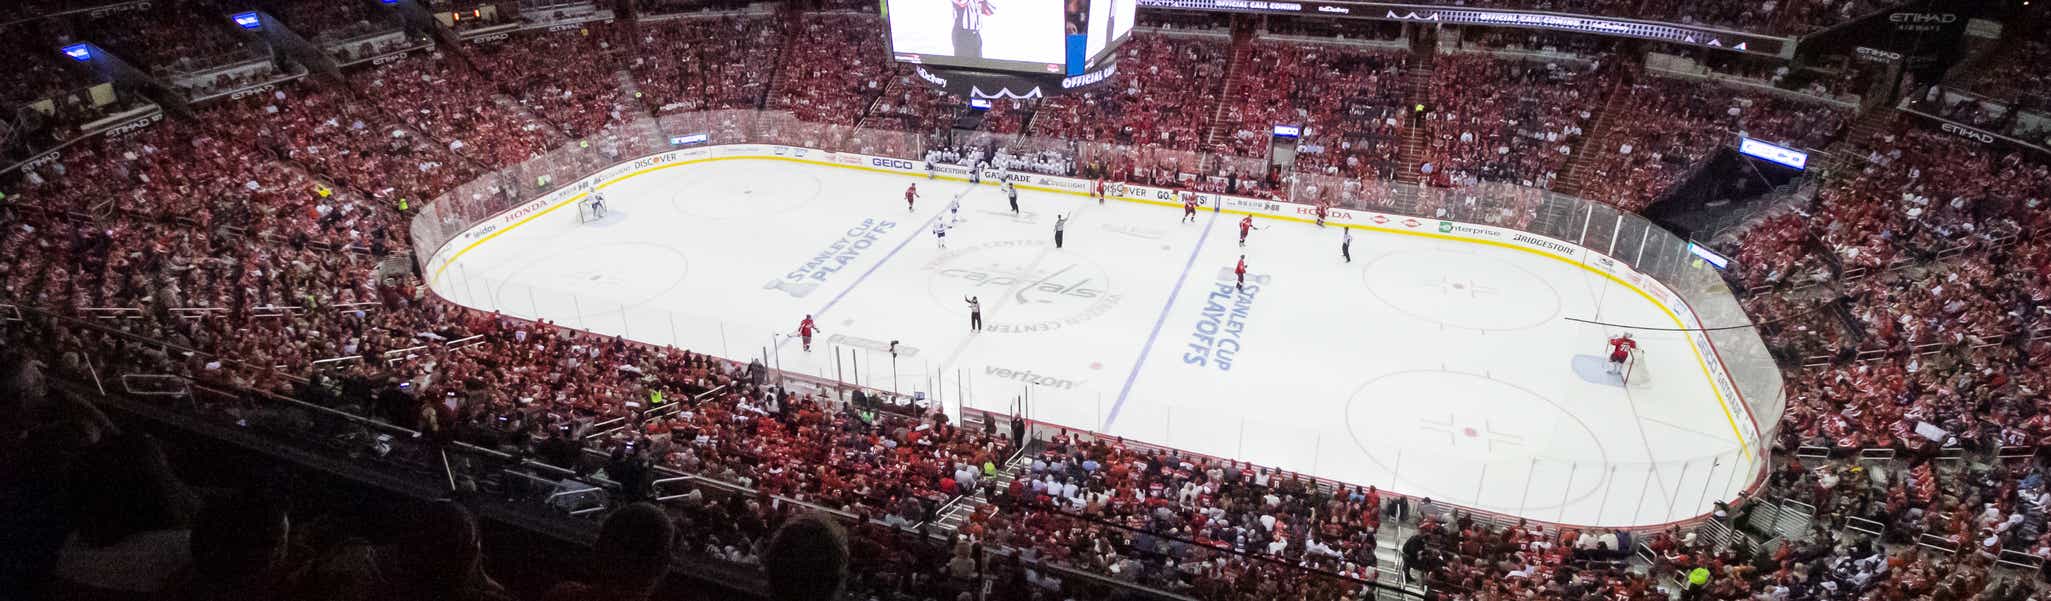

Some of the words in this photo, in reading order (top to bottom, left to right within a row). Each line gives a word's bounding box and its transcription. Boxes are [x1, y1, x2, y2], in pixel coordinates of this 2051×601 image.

[1216, 0, 1248, 9] OFFICIAL
[1250, 1, 1269, 10] CALL
[1269, 3, 1302, 12] COMING
[1889, 12, 1957, 24] ETIHAD
[473, 33, 509, 44] ETIHAD
[373, 52, 408, 65] ETIHAD
[1856, 46, 1900, 60] ETIHAD
[1062, 70, 1103, 88] OFFICIAL
[105, 118, 150, 136] ETIHAD
[1941, 123, 1994, 144] ETIHAD
[634, 153, 677, 169] DISCOVER
[872, 157, 913, 170] GEICO
[503, 200, 549, 223] HONDA
[473, 224, 497, 239] leidos
[787, 237, 850, 282] STANLEY
[847, 217, 874, 238] CUP
[809, 220, 897, 282] PLAYOFFS
[1513, 233, 1576, 256] BRIDGESTONE
[1183, 282, 1236, 367] PLAYOFFS
[1214, 338, 1241, 371] CUP
[984, 364, 1073, 390] verizon
